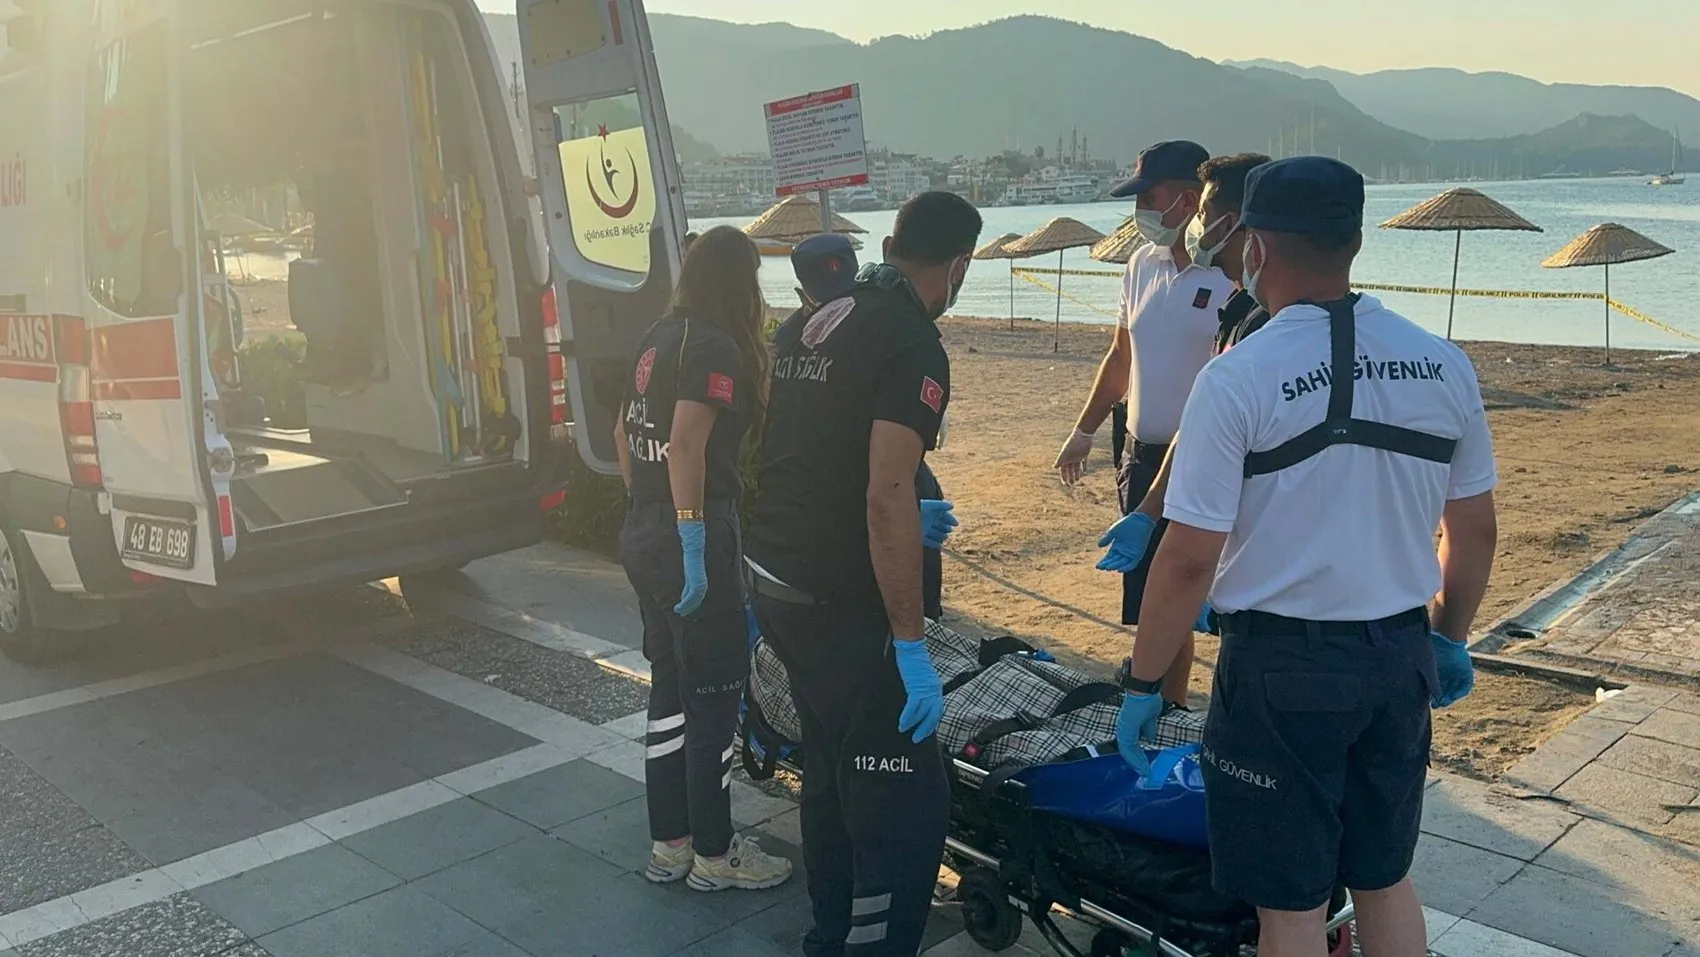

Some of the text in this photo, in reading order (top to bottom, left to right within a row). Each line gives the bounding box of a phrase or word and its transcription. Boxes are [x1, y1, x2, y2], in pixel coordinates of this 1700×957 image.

[1282, 361, 1332, 401] SAHİ
[628, 431, 671, 462] AĞLIK
[131, 523, 189, 558] 48 EB 698
[855, 755, 913, 773] 112 ACİL
[1220, 760, 1277, 790] GÜVENLİK
